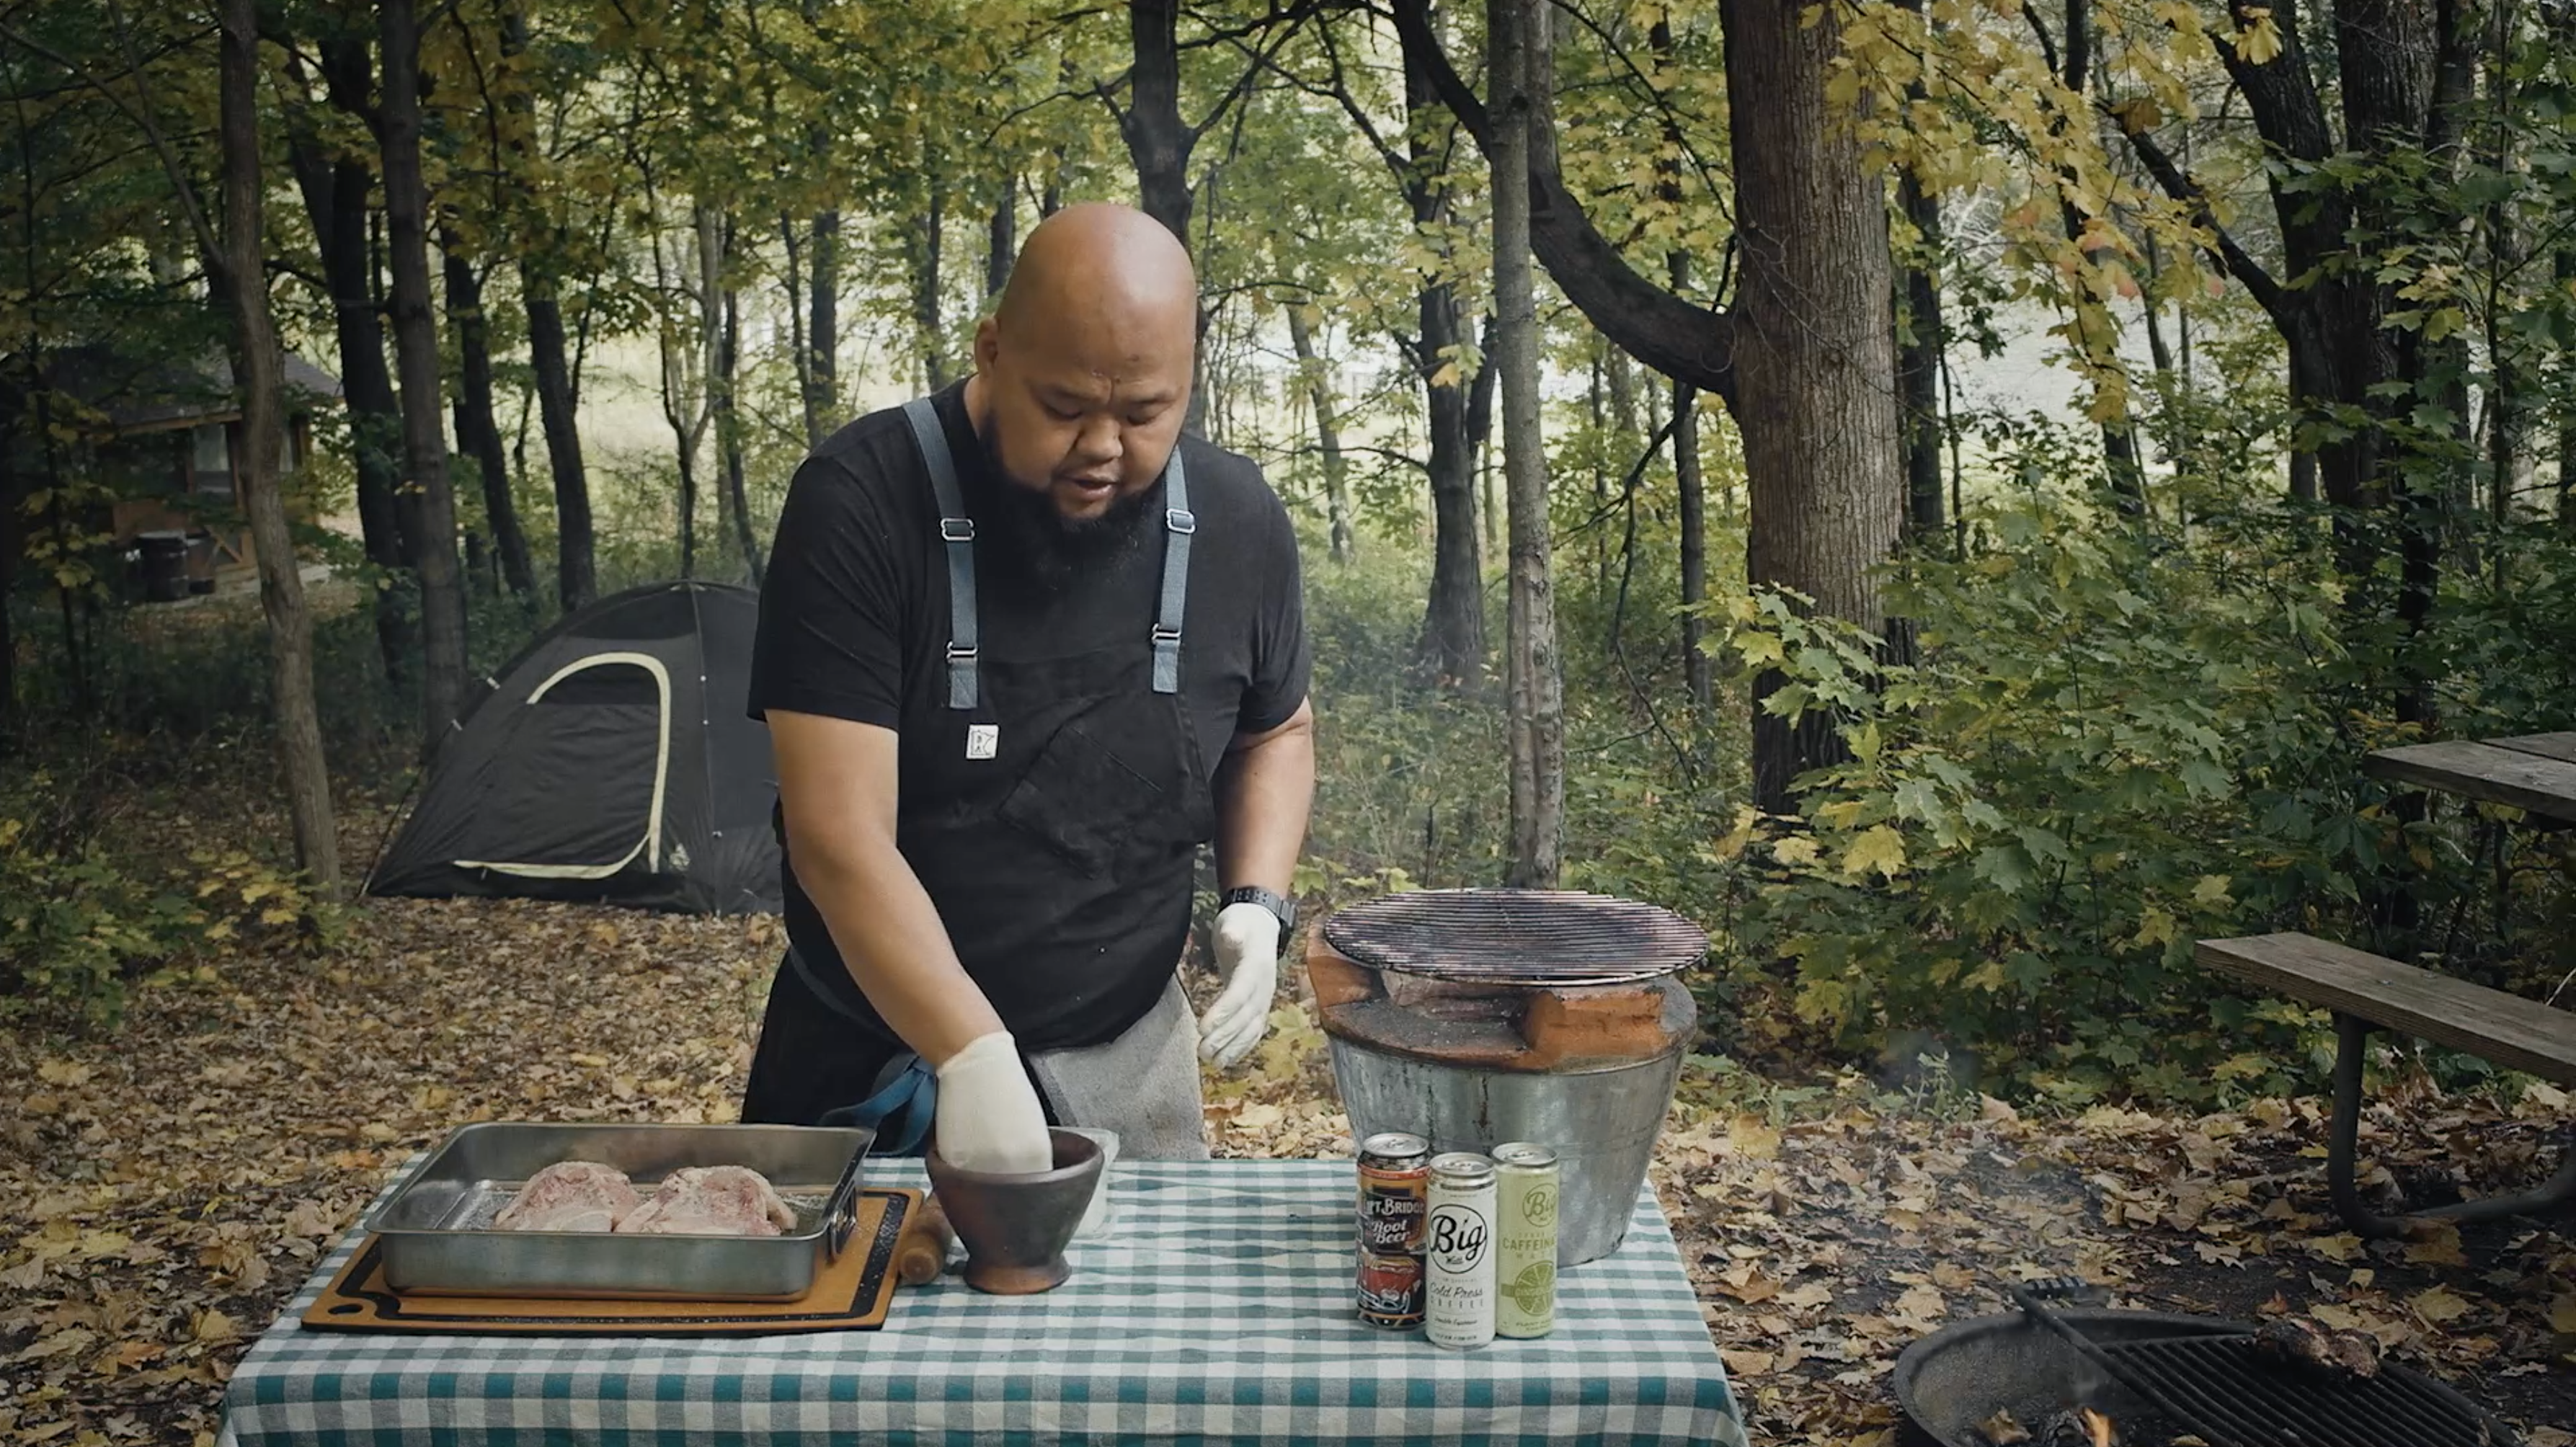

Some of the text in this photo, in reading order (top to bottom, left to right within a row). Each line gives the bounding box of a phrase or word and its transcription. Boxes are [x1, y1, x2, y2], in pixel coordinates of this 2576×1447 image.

[1372, 1219, 1408, 1233] Root
[1373, 1232, 1411, 1244] Beer
[1431, 1214, 1486, 1261] Big
[1430, 1282, 1483, 1298] Cold Press
